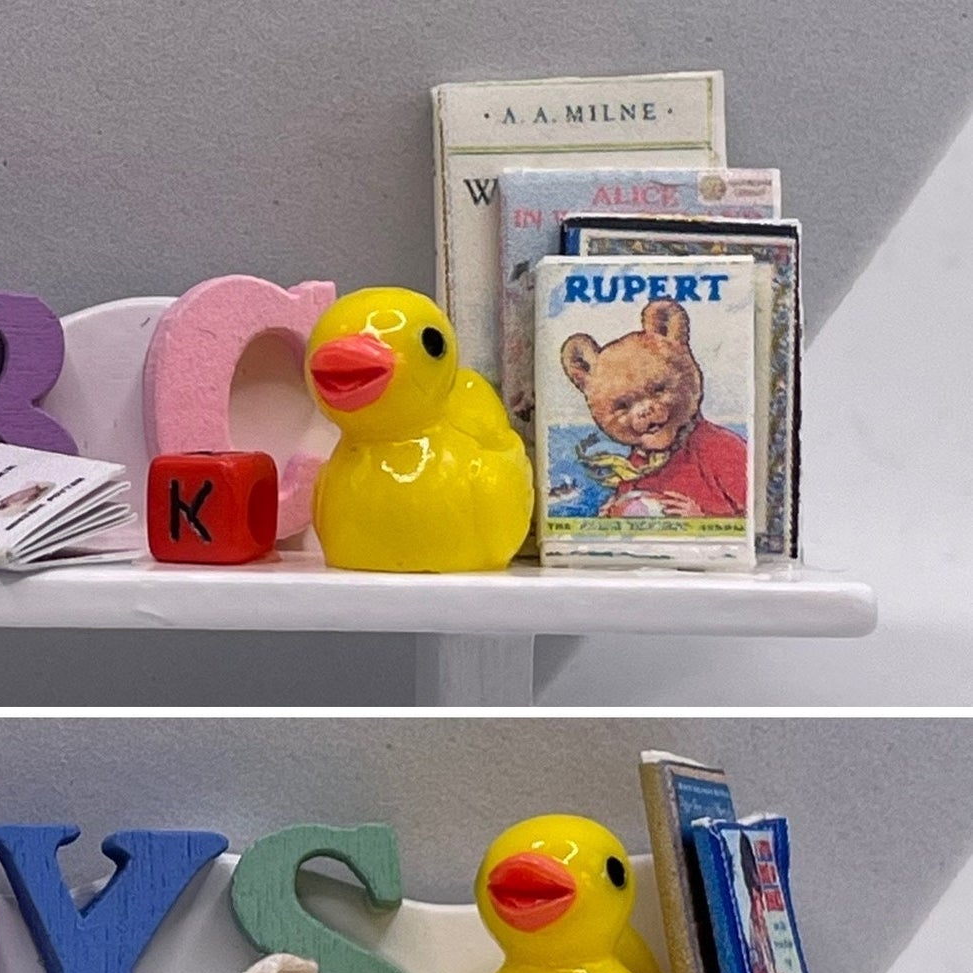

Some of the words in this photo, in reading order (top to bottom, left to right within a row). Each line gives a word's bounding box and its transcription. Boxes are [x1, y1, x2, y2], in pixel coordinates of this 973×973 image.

[565, 102, 658, 122] MILNE
[591, 184, 680, 206] ALICE
[563, 273, 729, 304] RUPERT
[167, 477, 213, 544] K
